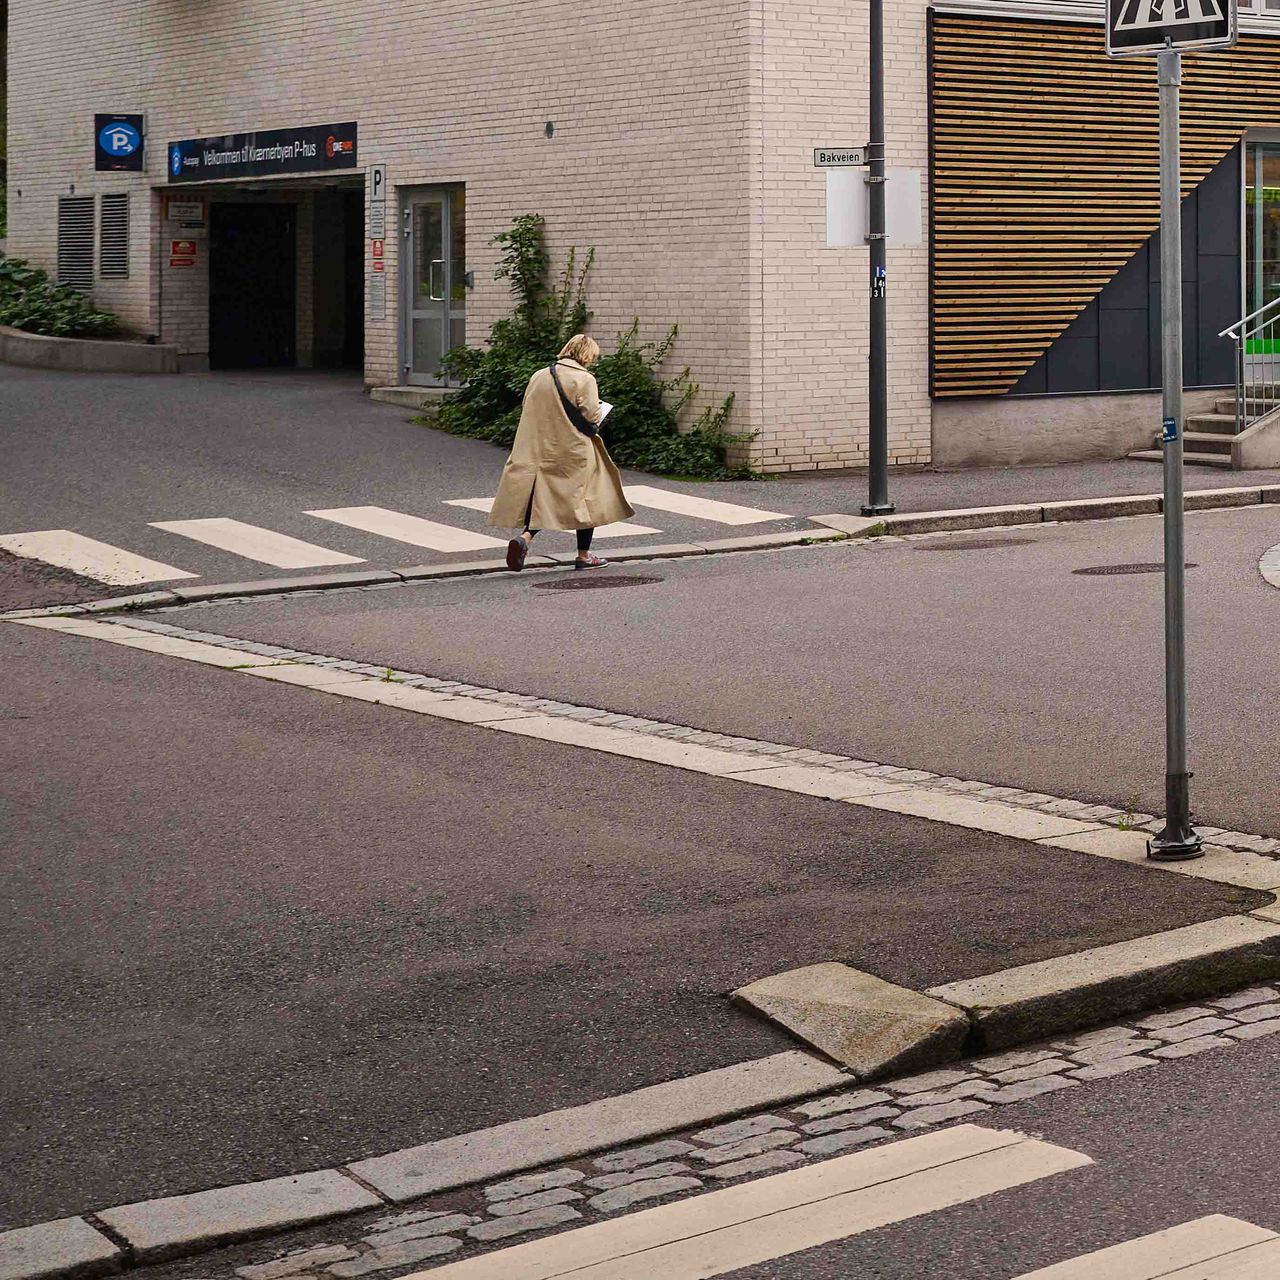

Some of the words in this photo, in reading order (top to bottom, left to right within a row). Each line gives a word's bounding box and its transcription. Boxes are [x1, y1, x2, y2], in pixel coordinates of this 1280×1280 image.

[203, 149, 241, 166] Velkommen
[241, 145, 250, 163] til
[294, 140, 317, 158] P-hus
[820, 152, 860, 163] Bakveien
[373, 169, 382, 196] P
